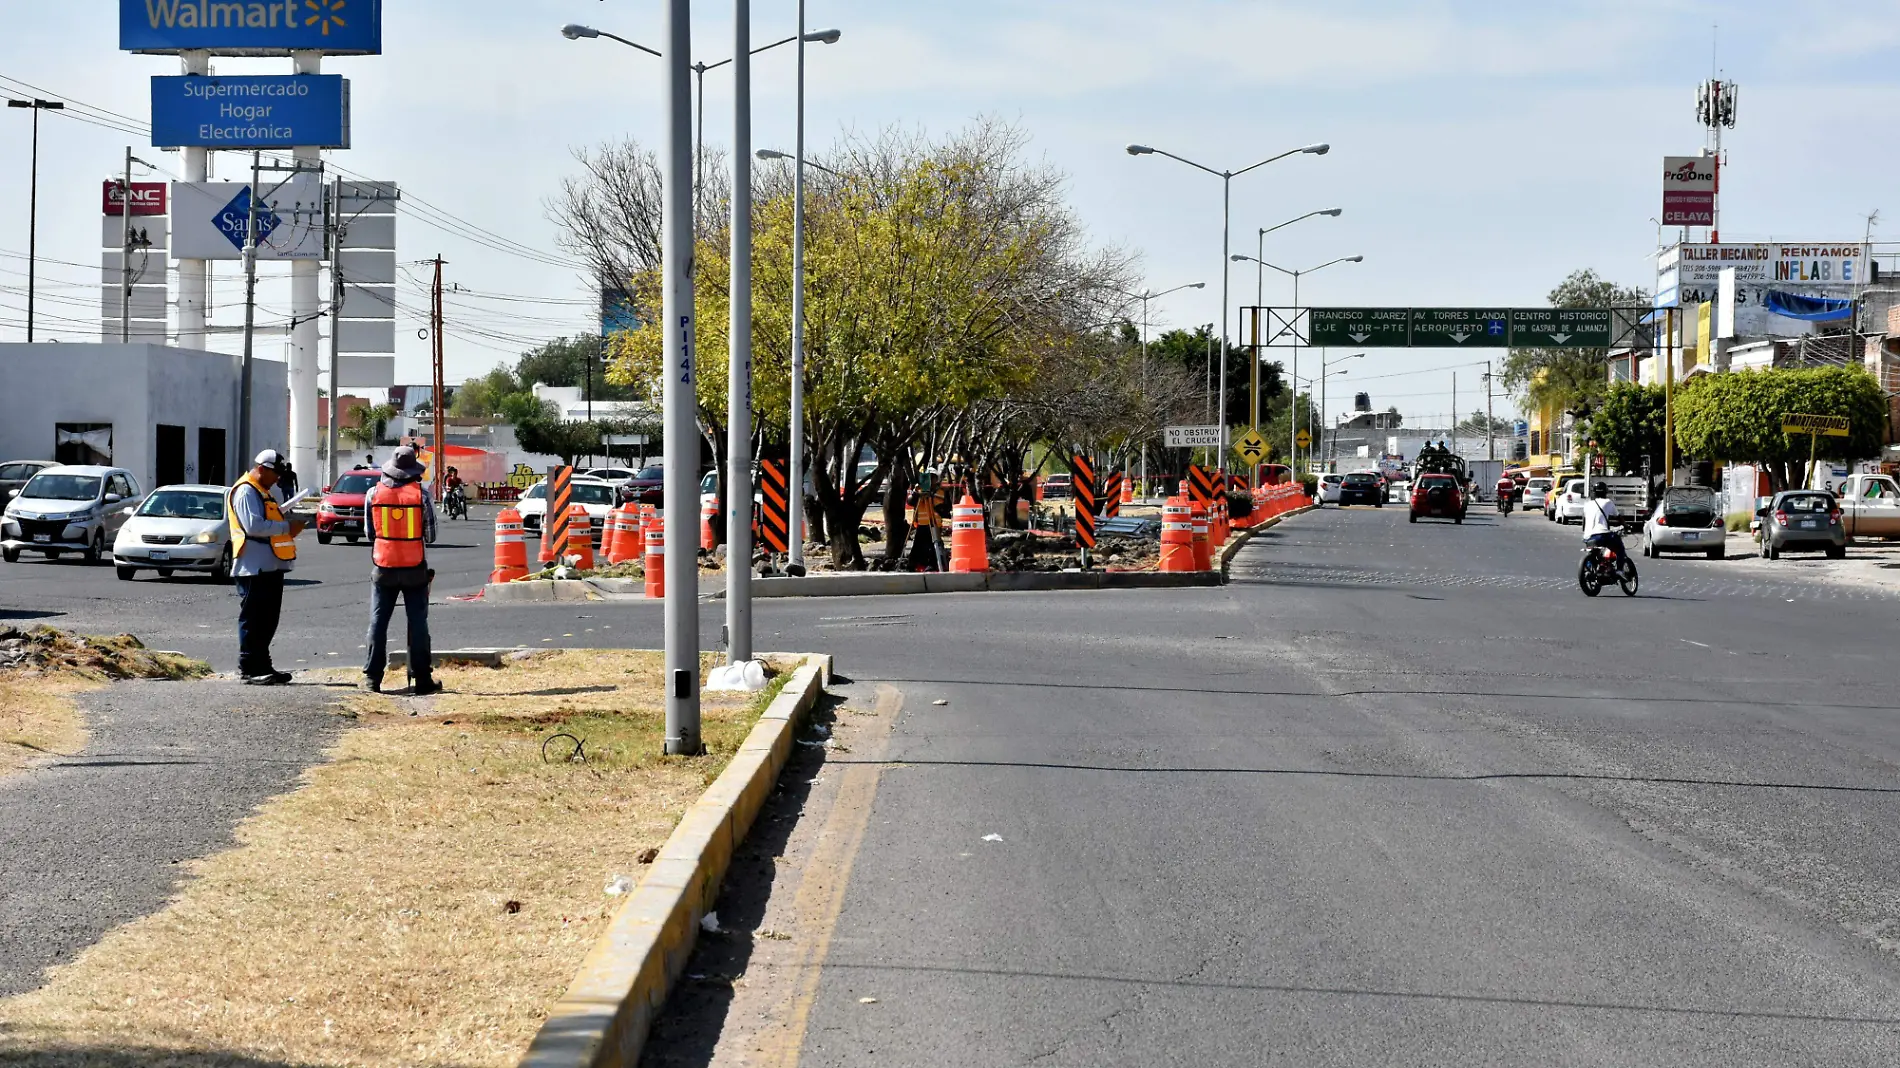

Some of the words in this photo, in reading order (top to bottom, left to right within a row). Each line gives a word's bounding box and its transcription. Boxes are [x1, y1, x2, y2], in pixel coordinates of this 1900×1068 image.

[144, 0, 298, 29] Walmart
[183, 81, 309, 99] Supermercado
[220, 102, 272, 121] Hogar
[199, 123, 293, 139] Electrónica
[1665, 211, 1711, 221] CELAYA
[1682, 248, 1718, 260] TALLER
[1720, 248, 1769, 260] MECANICO
[1781, 247, 1861, 257] RENTAMOS
[1313, 311, 1363, 320] FRANCISCO
[1370, 311, 1407, 320] JUAREZ
[1413, 311, 1426, 320] AV.
[1433, 311, 1469, 320] TORRES
[1475, 311, 1507, 320] LANDA
[1513, 312, 1551, 320] CENTRO
[1559, 312, 1608, 320] HISTORICO
[1315, 323, 1337, 332] EJE
[1349, 323, 1405, 332] NOR-PTE
[1413, 324, 1483, 332] AEROPUERTO
[1513, 324, 1526, 332] POR
[1531, 324, 1556, 332] GASPAR
[1561, 324, 1570, 332] DE
[1576, 324, 1608, 332] ALMANZA
[1782, 414, 1849, 430] AMORTIGUADORES
[1169, 429, 1180, 437] NO
[1172, 437, 1182, 445] EL
